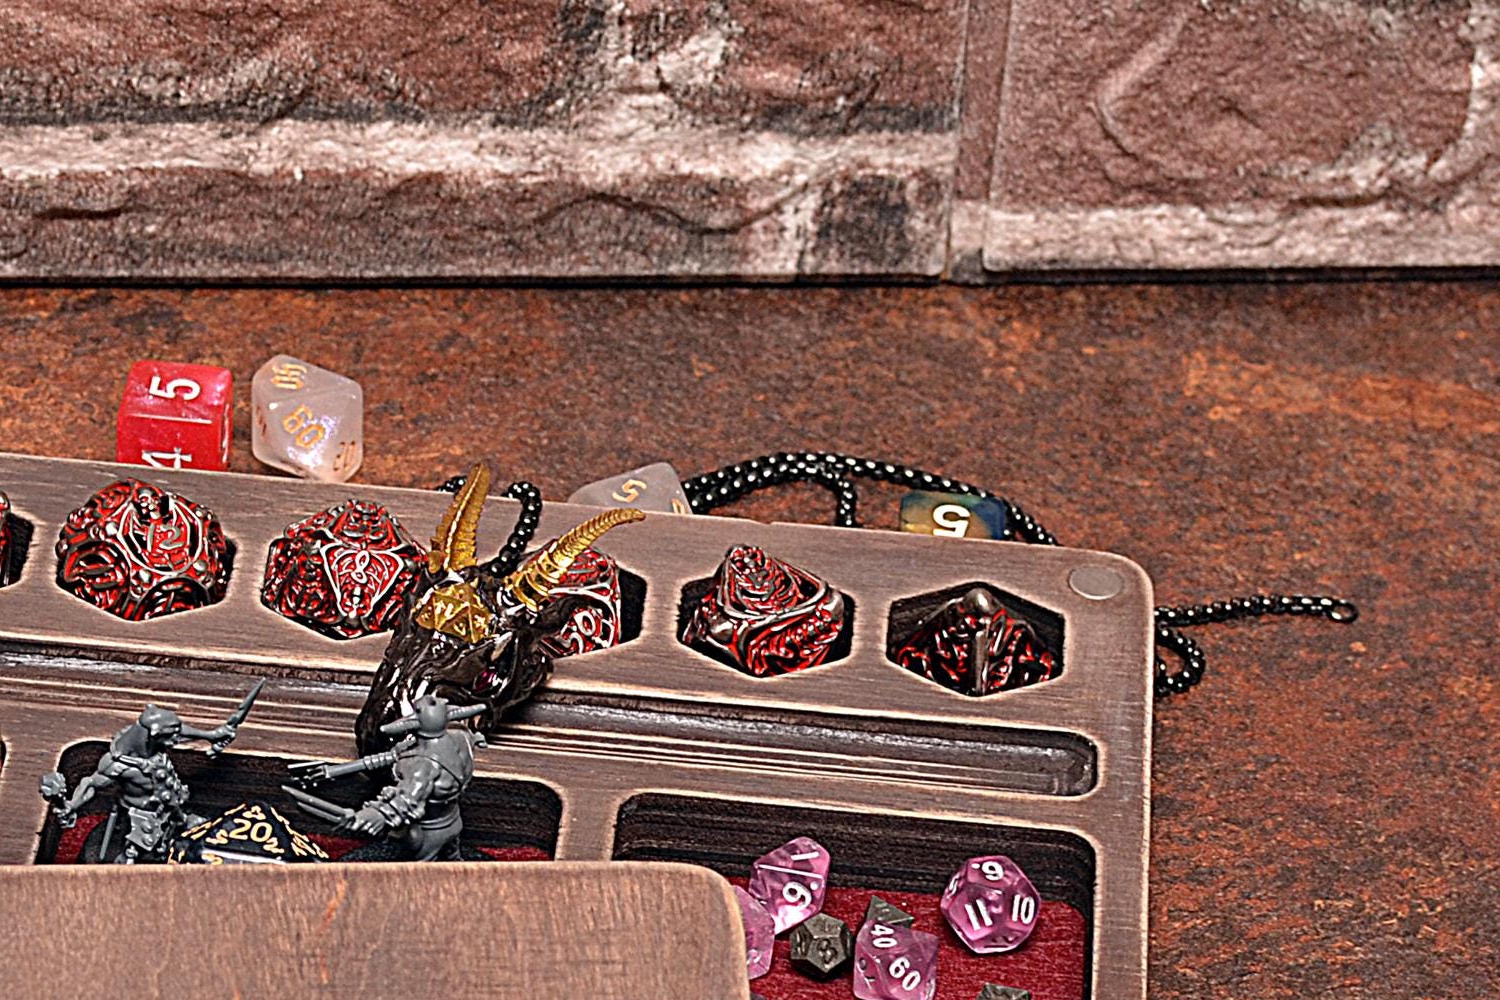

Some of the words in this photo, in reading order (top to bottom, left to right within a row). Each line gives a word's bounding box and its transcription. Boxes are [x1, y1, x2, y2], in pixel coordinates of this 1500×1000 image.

[148, 375, 200, 400] 5
[932, 504, 972, 538] 5
[354, 549, 370, 584] 8
[229, 817, 273, 843] 20
[964, 898, 993, 931] 11
[1011, 894, 1035, 925] 10
[871, 924, 898, 949] 40
[889, 956, 921, 991] 60
